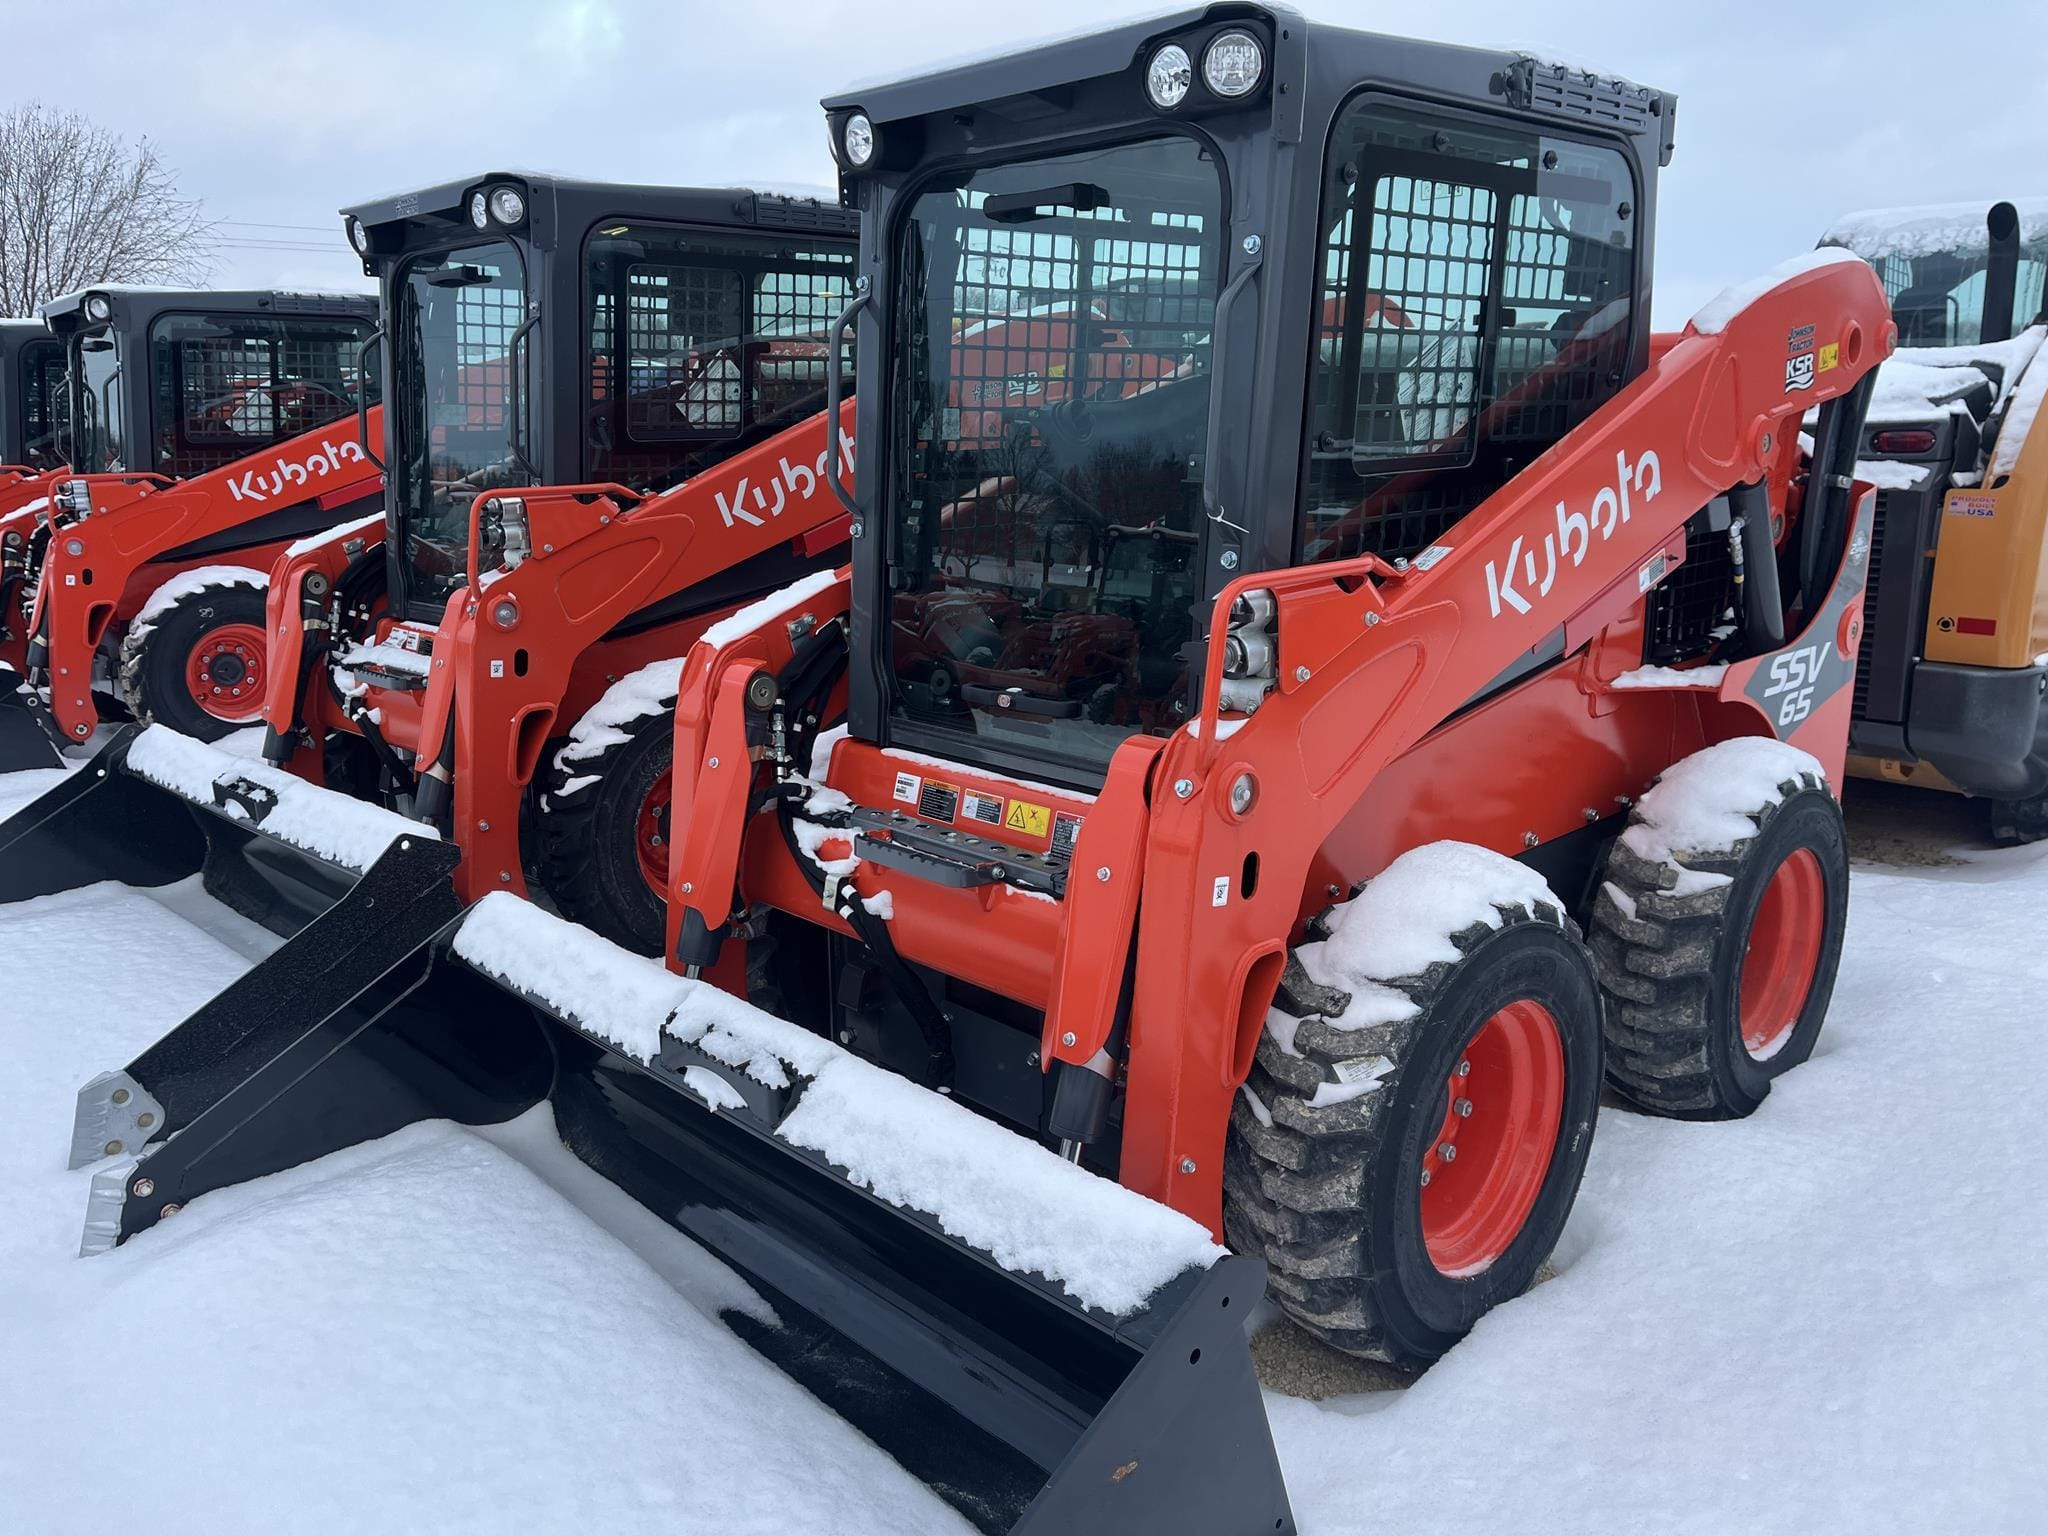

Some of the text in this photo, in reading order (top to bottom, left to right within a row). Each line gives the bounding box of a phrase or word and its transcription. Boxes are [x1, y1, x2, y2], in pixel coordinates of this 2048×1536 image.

[1786, 353, 1813, 379] KSR
[227, 441, 365, 501] Kubota
[714, 427, 855, 528] Kubot
[1485, 449, 1661, 618] Kubota
[1764, 641, 1832, 697] SSV
[1779, 686, 1815, 726] 65
